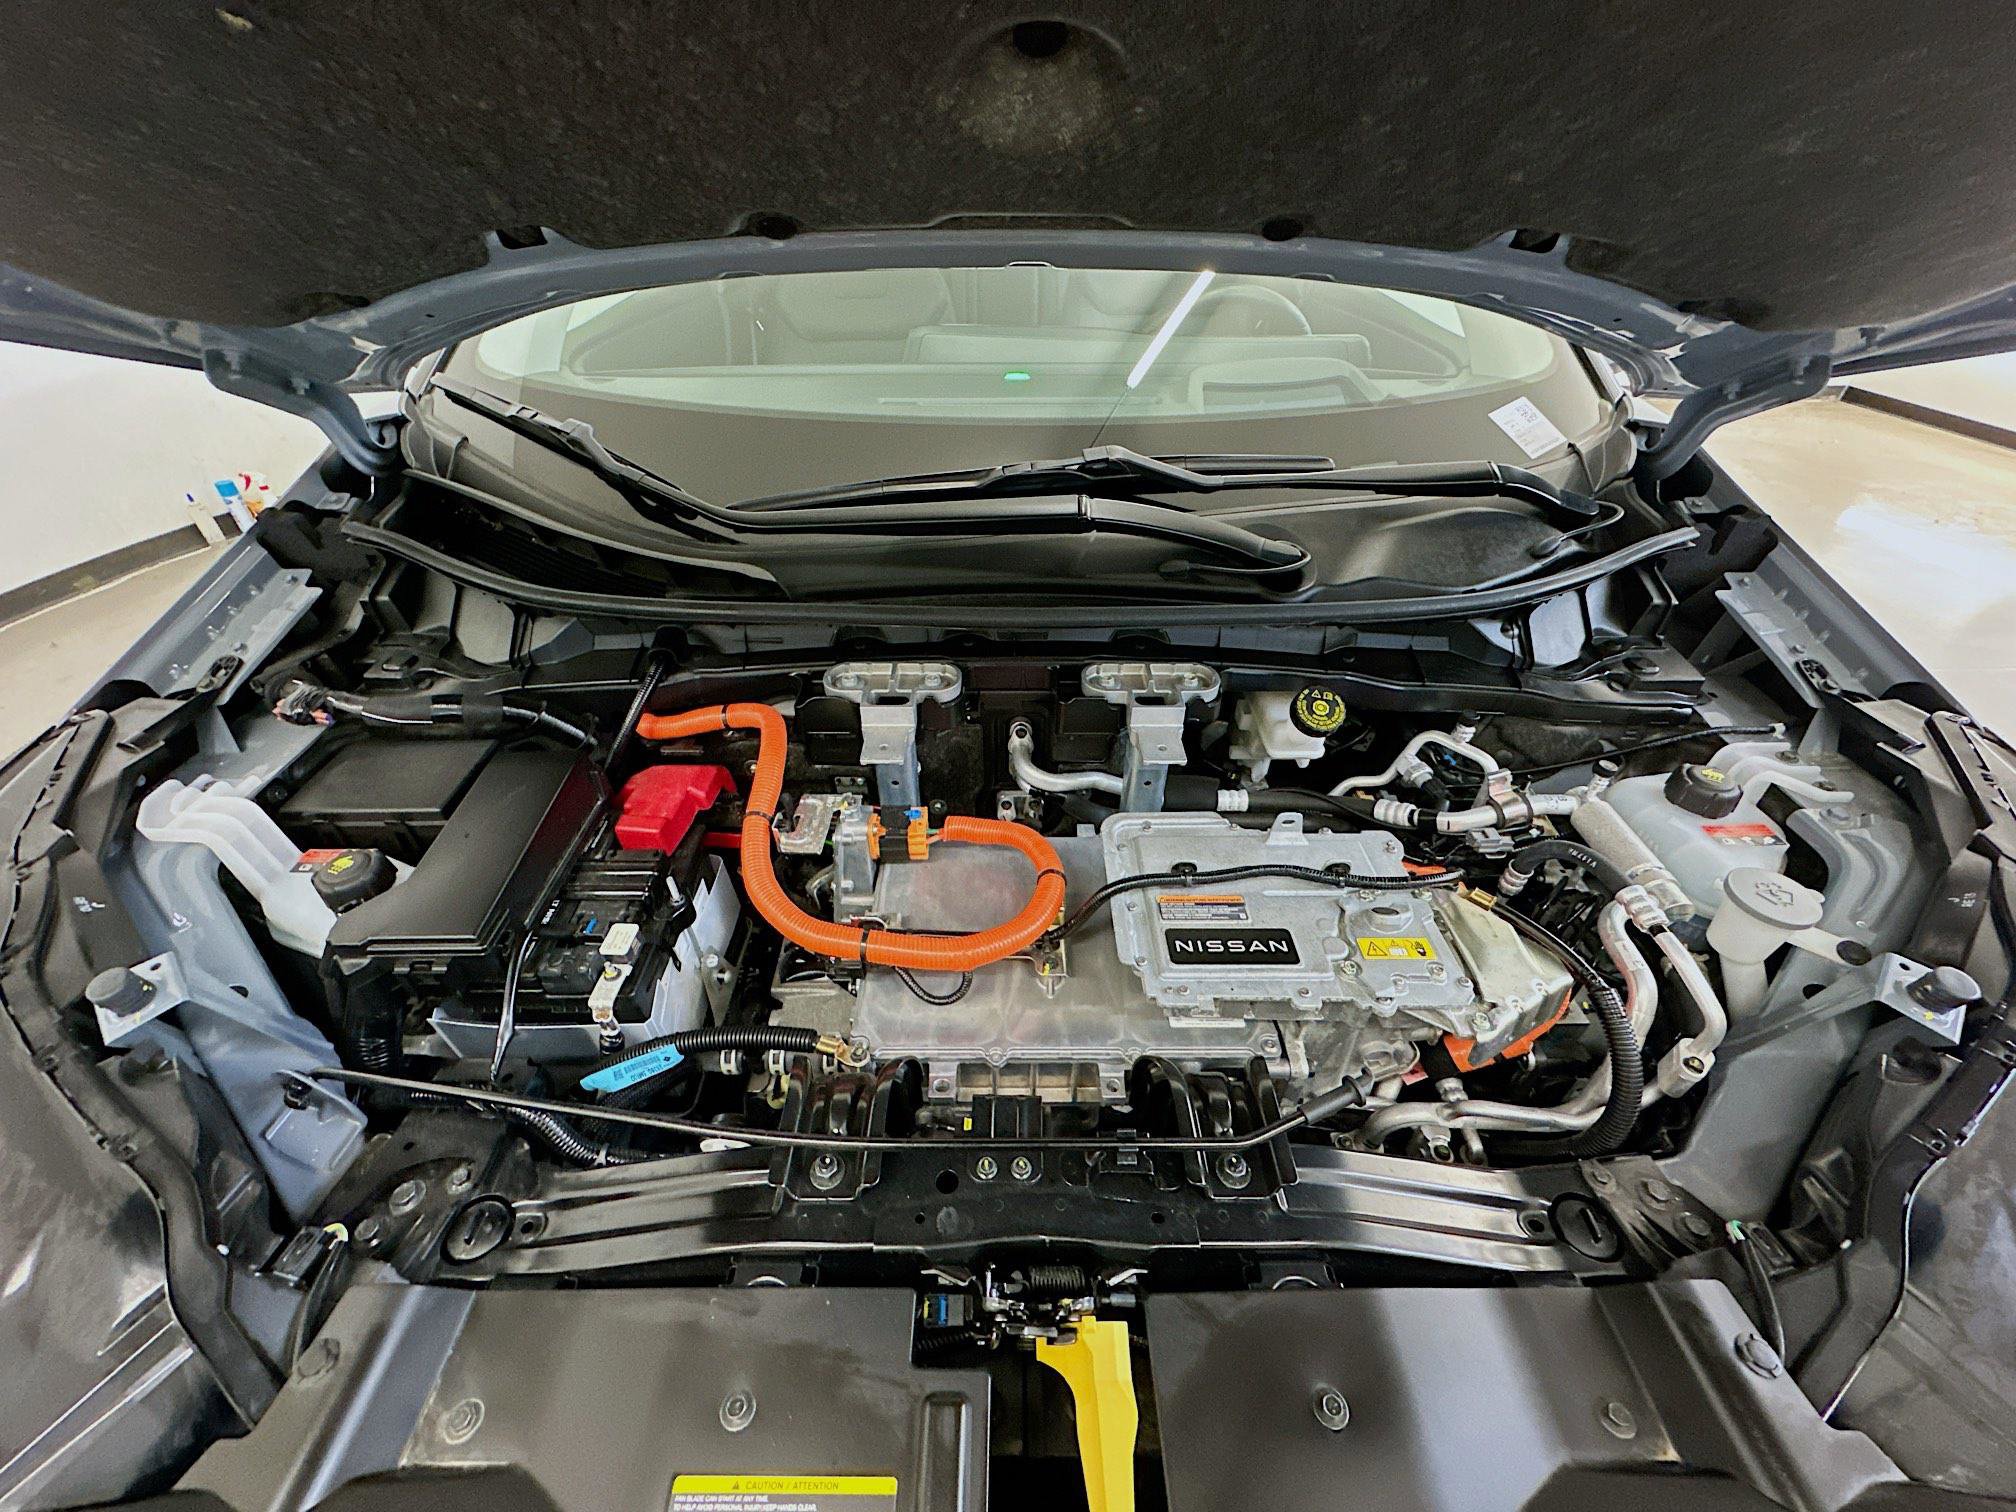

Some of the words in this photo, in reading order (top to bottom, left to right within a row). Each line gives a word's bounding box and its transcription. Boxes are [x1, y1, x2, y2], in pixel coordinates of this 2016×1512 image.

[1175, 940, 1288, 952] NISSAN
[746, 1481, 784, 1490] CAUTION
[793, 1481, 839, 1490] ATTENTION
